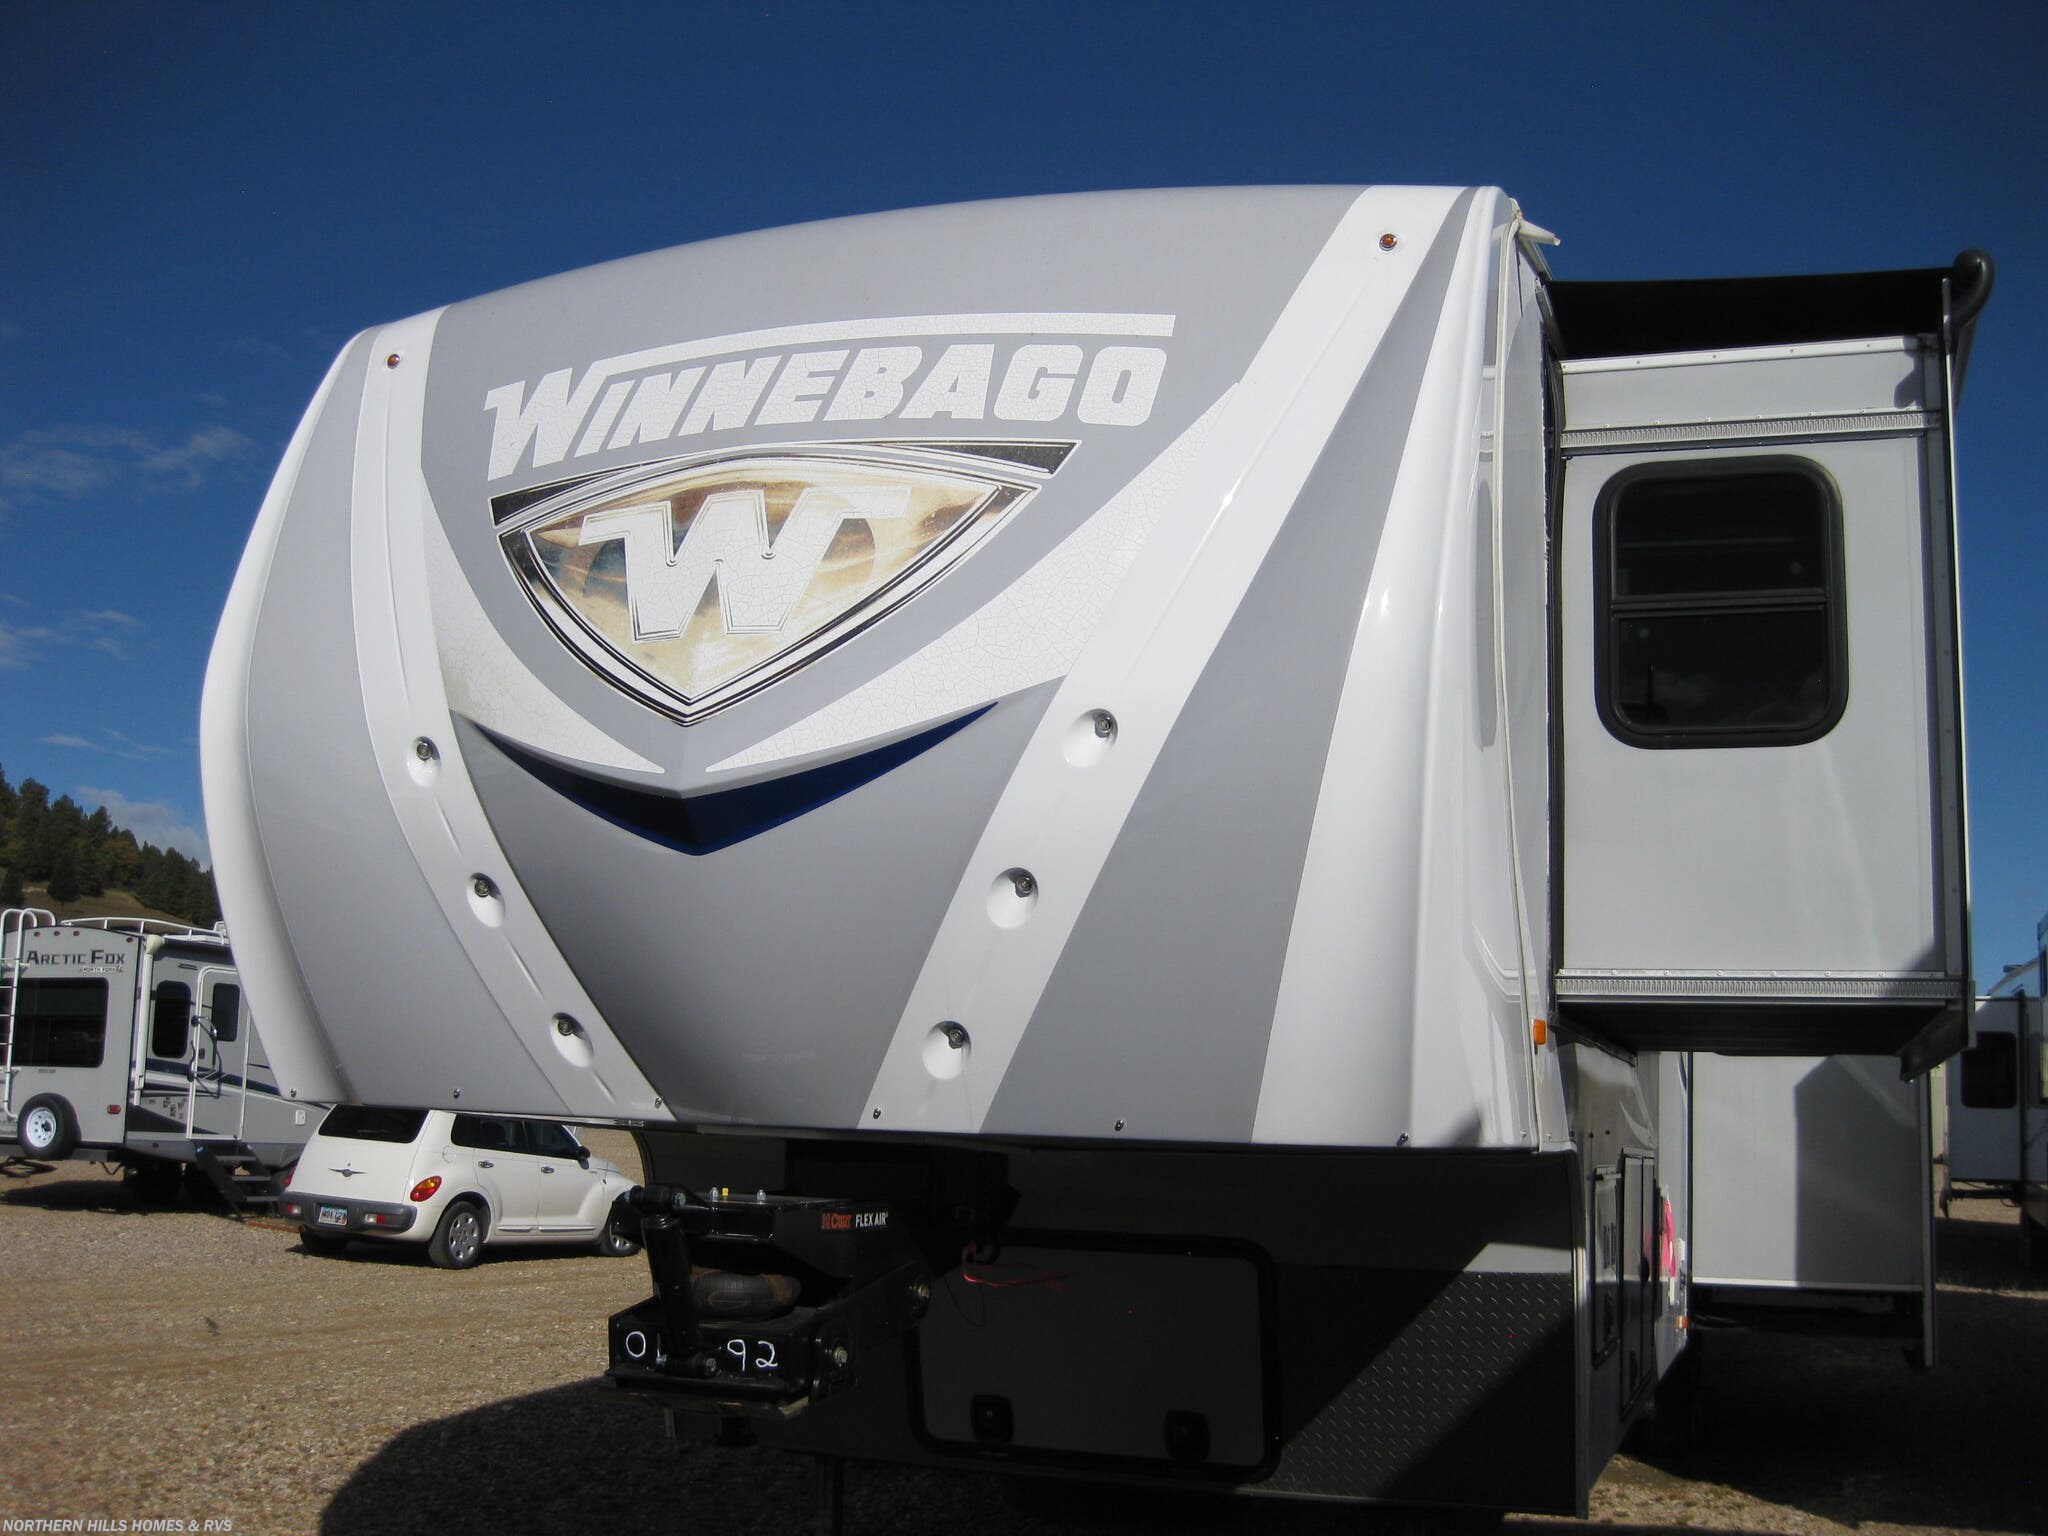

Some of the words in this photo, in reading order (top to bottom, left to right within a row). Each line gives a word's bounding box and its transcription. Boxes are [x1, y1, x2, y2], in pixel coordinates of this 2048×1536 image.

[483, 313, 1175, 481] WINNEBAGO
[578, 486, 912, 643] W
[26, 950, 87, 965] ARCTIC
[91, 949, 126, 964] FOX
[855, 1213, 873, 1228] FLEX
[727, 1339, 778, 1371] 92
